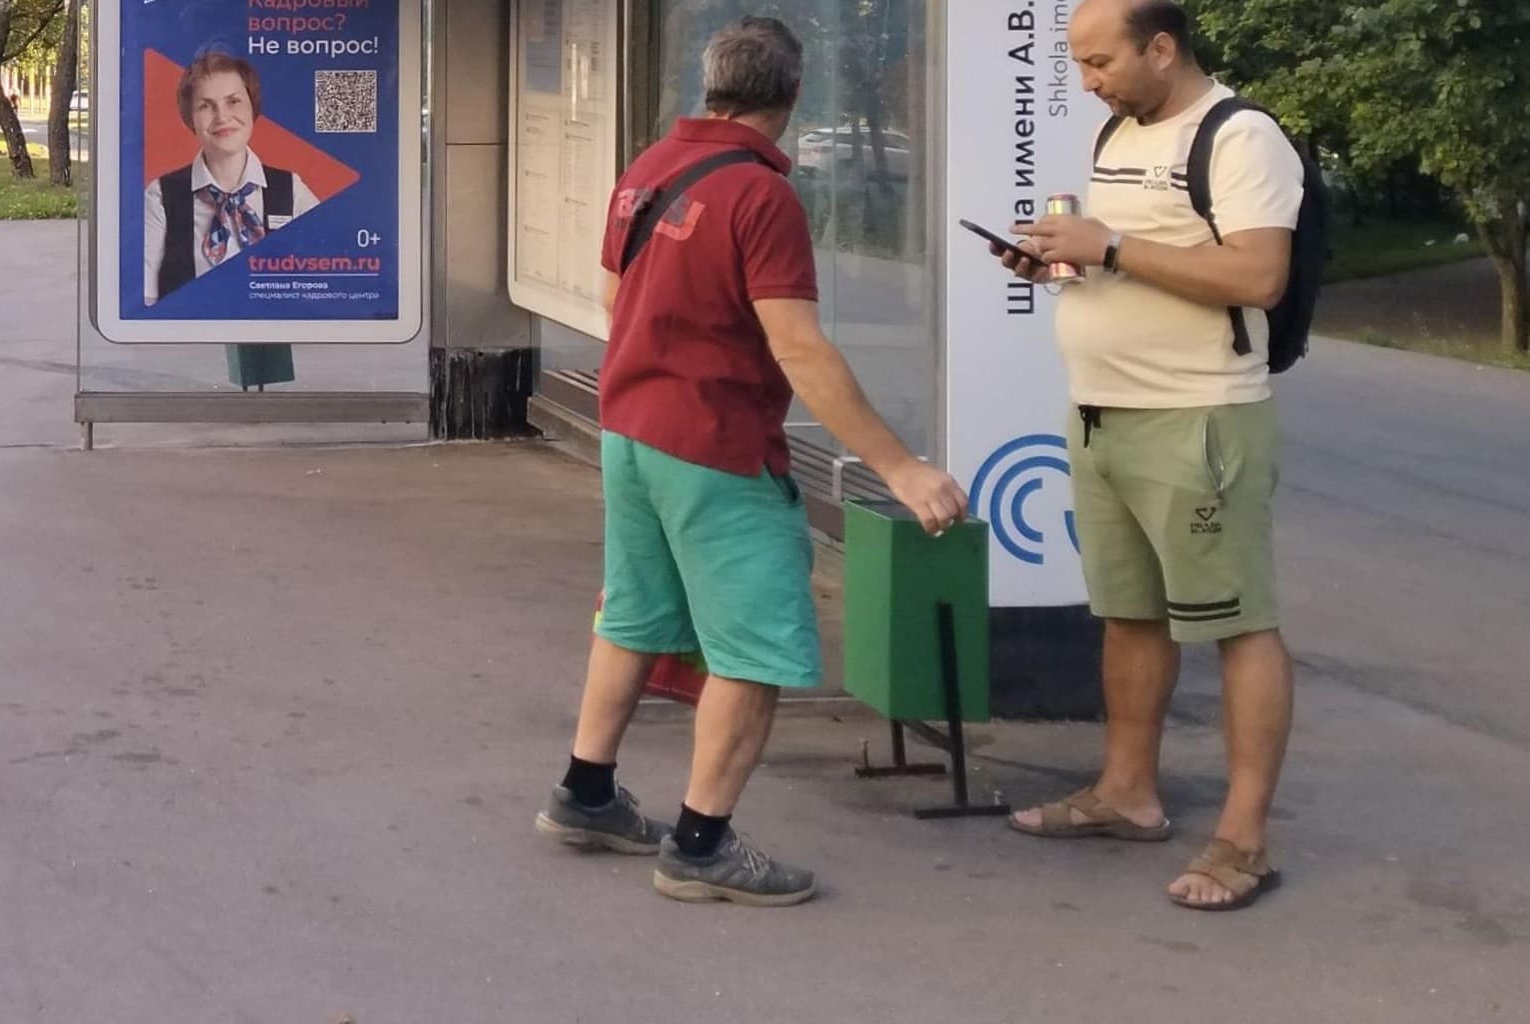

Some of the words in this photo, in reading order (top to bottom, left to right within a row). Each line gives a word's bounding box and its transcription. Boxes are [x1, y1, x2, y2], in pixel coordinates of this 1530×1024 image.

[248, 14, 346, 34] вопрос?
[248, 36, 279, 54] Не
[287, 36, 378, 58] вопрос!
[1048, 40, 1068, 117] Shkola
[1015, 76, 1034, 186] имени
[357, 229, 381, 248] 0+
[248, 254, 381, 272] trudvsem.ru
